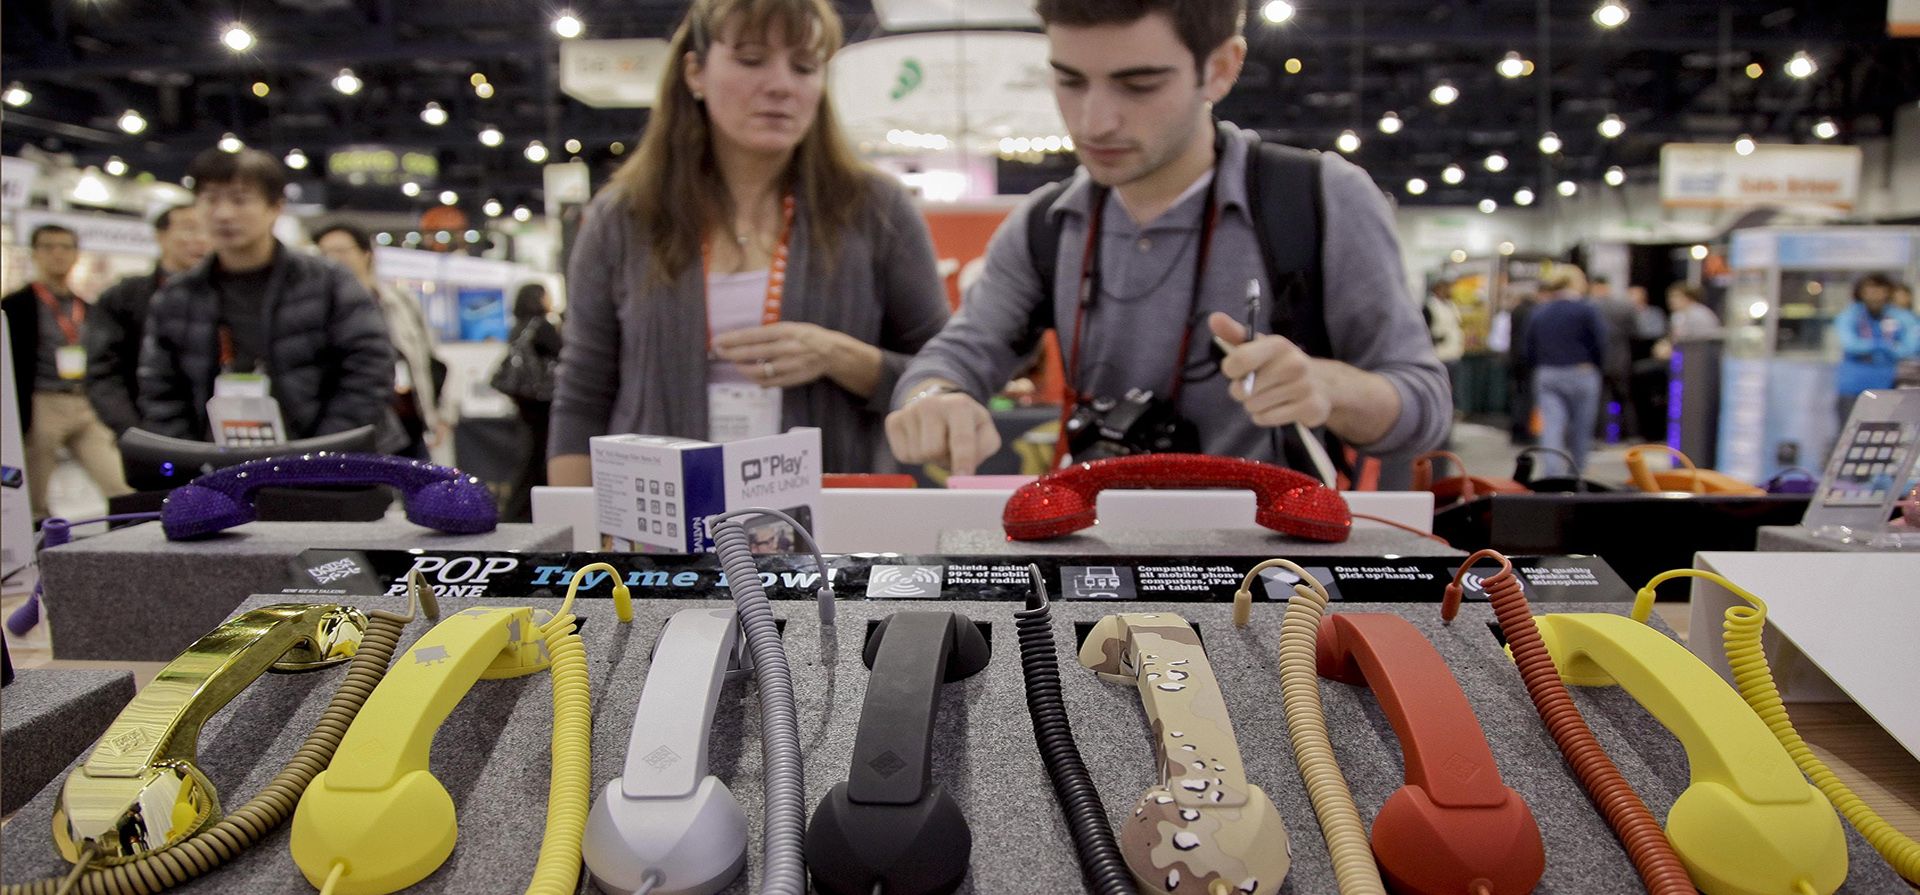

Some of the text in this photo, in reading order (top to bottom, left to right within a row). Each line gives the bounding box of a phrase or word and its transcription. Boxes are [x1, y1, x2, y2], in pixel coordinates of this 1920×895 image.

[741, 476, 810, 499] NATIVE UNION
[394, 556, 519, 584] POP
[948, 563, 1031, 573] Shields agains
[1137, 565, 1204, 573] Compatible
[530, 566, 610, 591] Try
[624, 571, 699, 587] me
[1339, 572, 1364, 580] pick
[1365, 572, 1416, 580] up/hang
[1140, 578, 1207, 586] computers,
[383, 584, 488, 597] PONE
